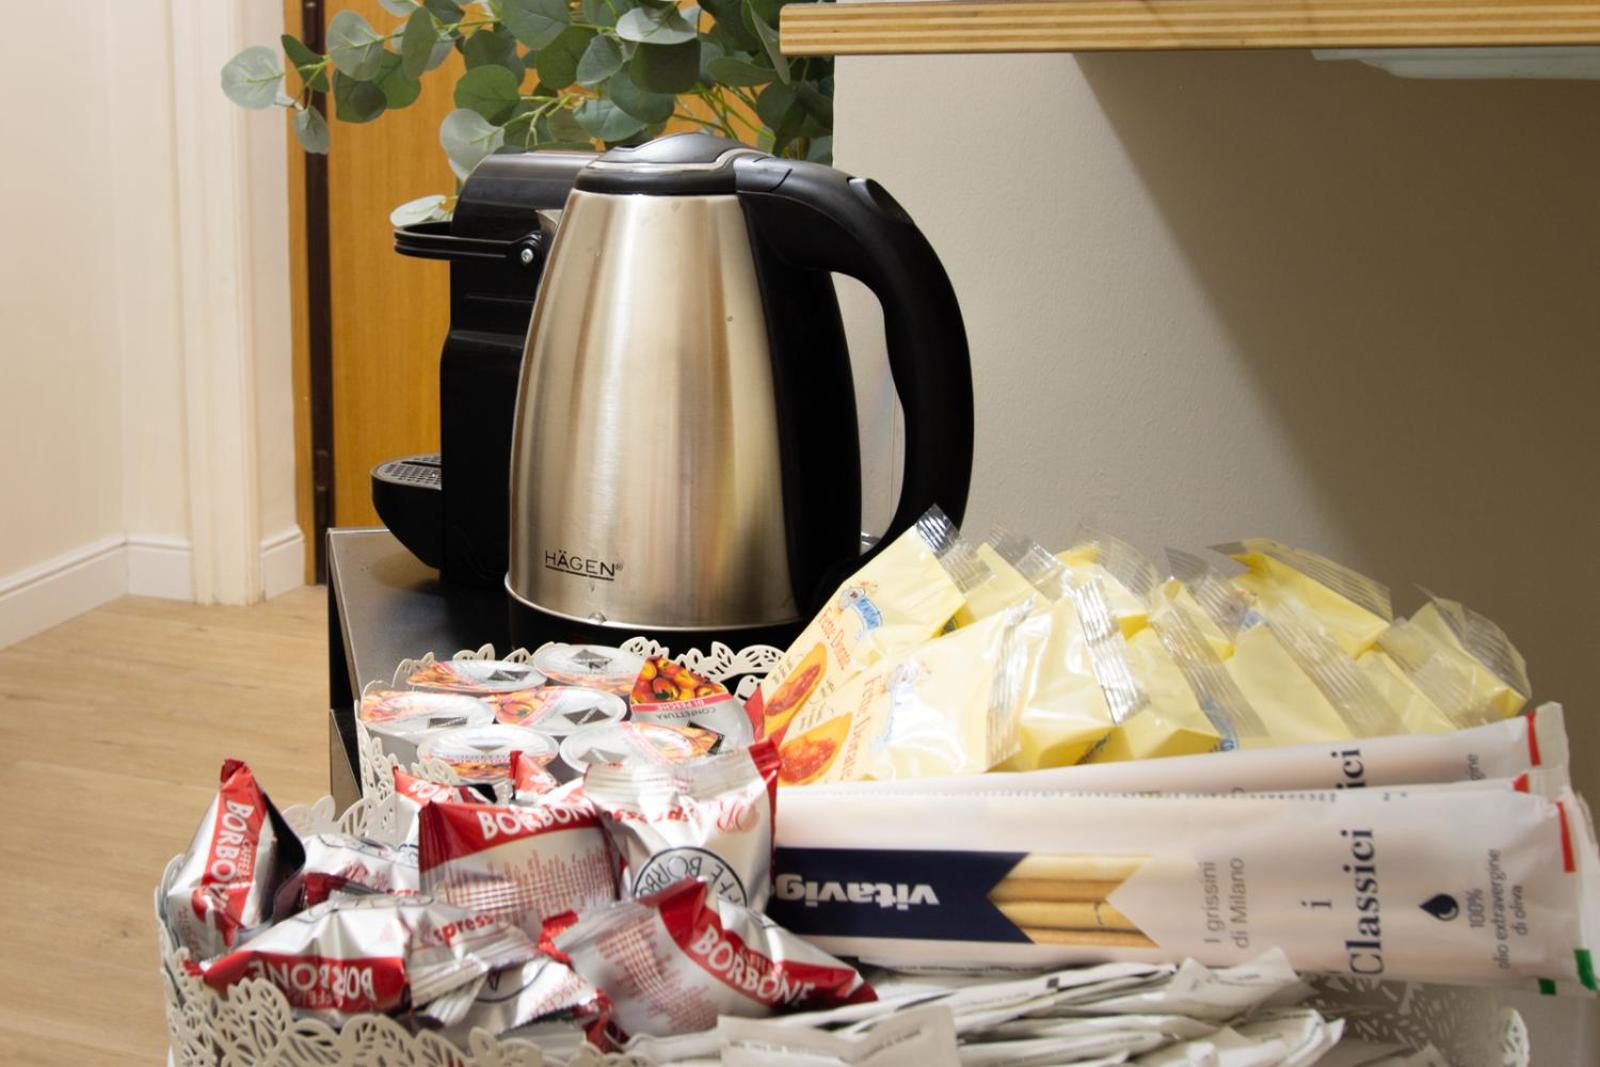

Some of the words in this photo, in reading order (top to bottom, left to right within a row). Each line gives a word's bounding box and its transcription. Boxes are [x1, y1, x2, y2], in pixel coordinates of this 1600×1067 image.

[656, 707, 716, 720] CONFETTURA
[476, 803, 597, 840] BORBON
[768, 873, 939, 910] vitavig
[1205, 860, 1224, 933] grissini
[1230, 856, 1248, 924] Milano
[1302, 899, 1332, 910] i
[1340, 828, 1385, 977] Classici
[1469, 887, 1484, 929] 100%
[1487, 848, 1508, 941] extravergine
[1232, 930, 1249, 949] di
[1492, 943, 1510, 970] olio
[690, 926, 815, 1006] BORBONE
